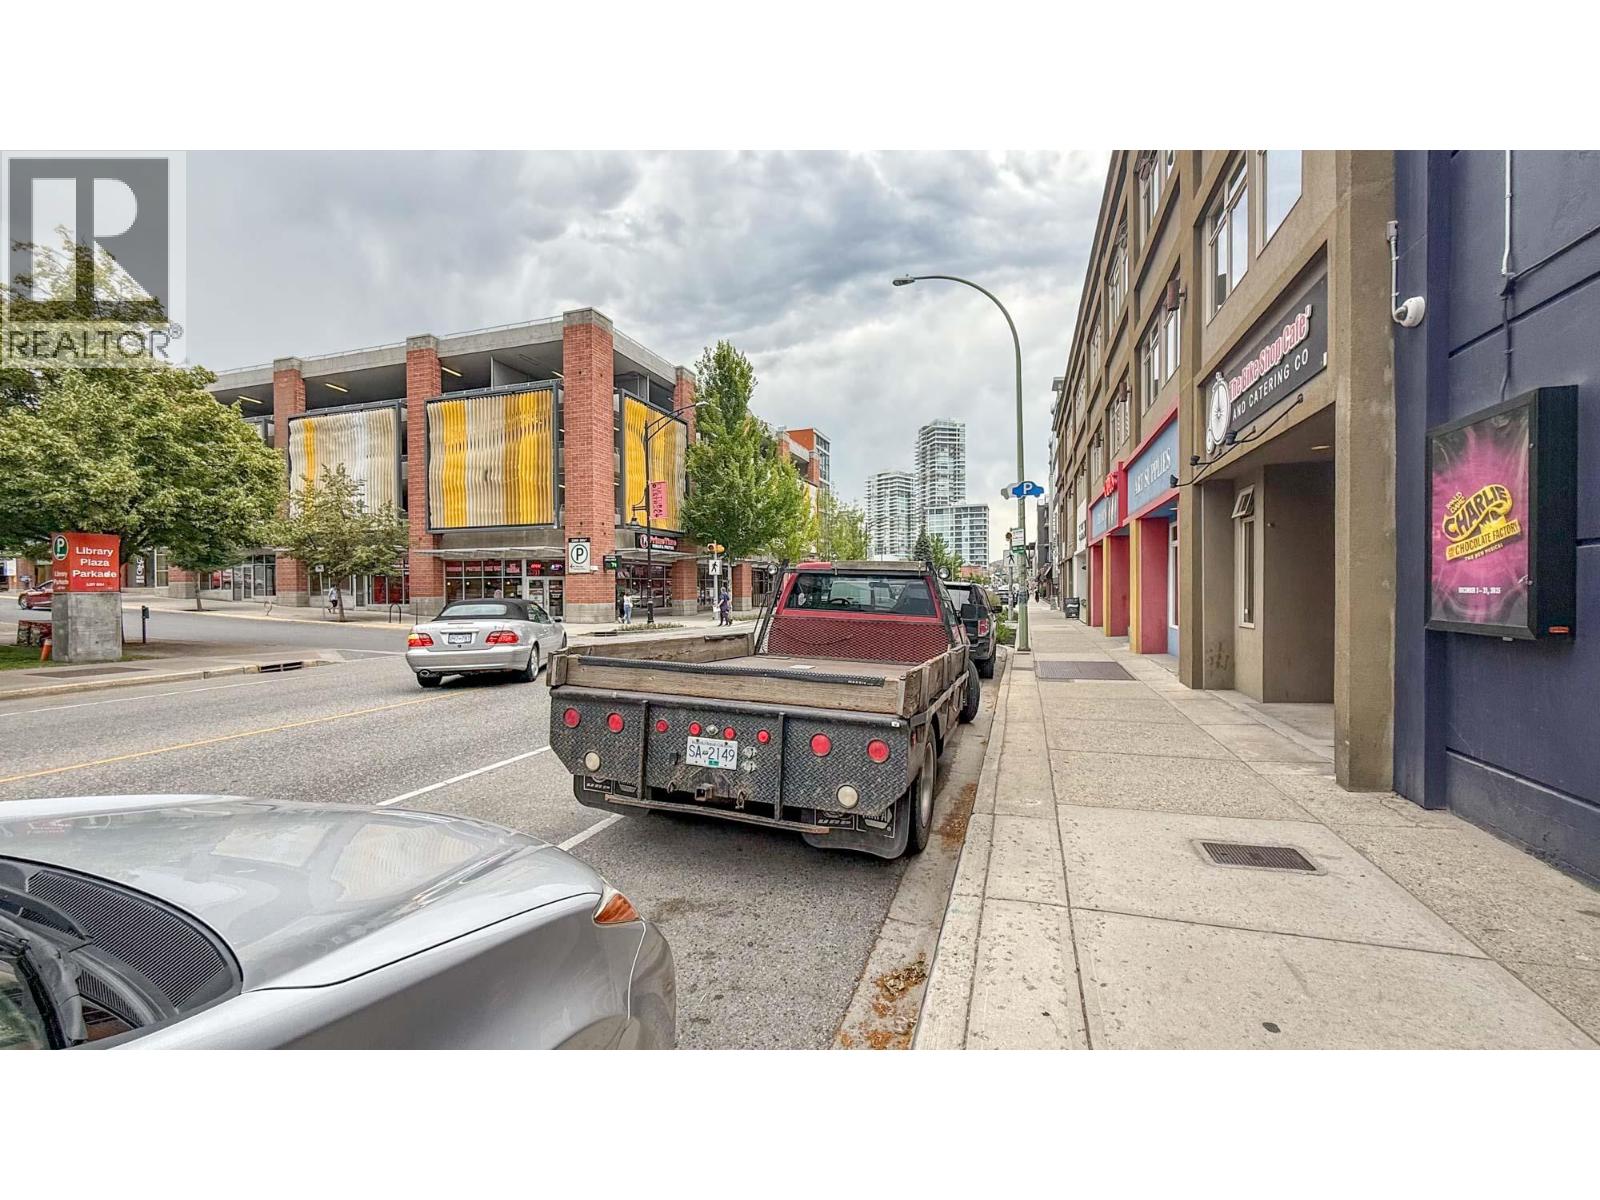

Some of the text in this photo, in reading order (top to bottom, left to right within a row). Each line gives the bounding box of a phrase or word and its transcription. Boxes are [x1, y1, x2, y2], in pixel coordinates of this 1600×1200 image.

[1229, 376, 1242, 403] The
[1241, 359, 1260, 393] Bike
[1259, 336, 1282, 377] Shop
[1232, 348, 1309, 421] AND CATERING CO
[1023, 482, 1033, 495] P
[1444, 486, 1508, 539] CHARLIE
[56, 538, 65, 552] P
[1455, 534, 1492, 555] CHOCOLATE
[1492, 522, 1519, 541] FACTORY
[76, 546, 114, 557] Library
[576, 547, 584, 561] P
[80, 558, 110, 567] Plaza
[72, 569, 117, 578] Parkade
